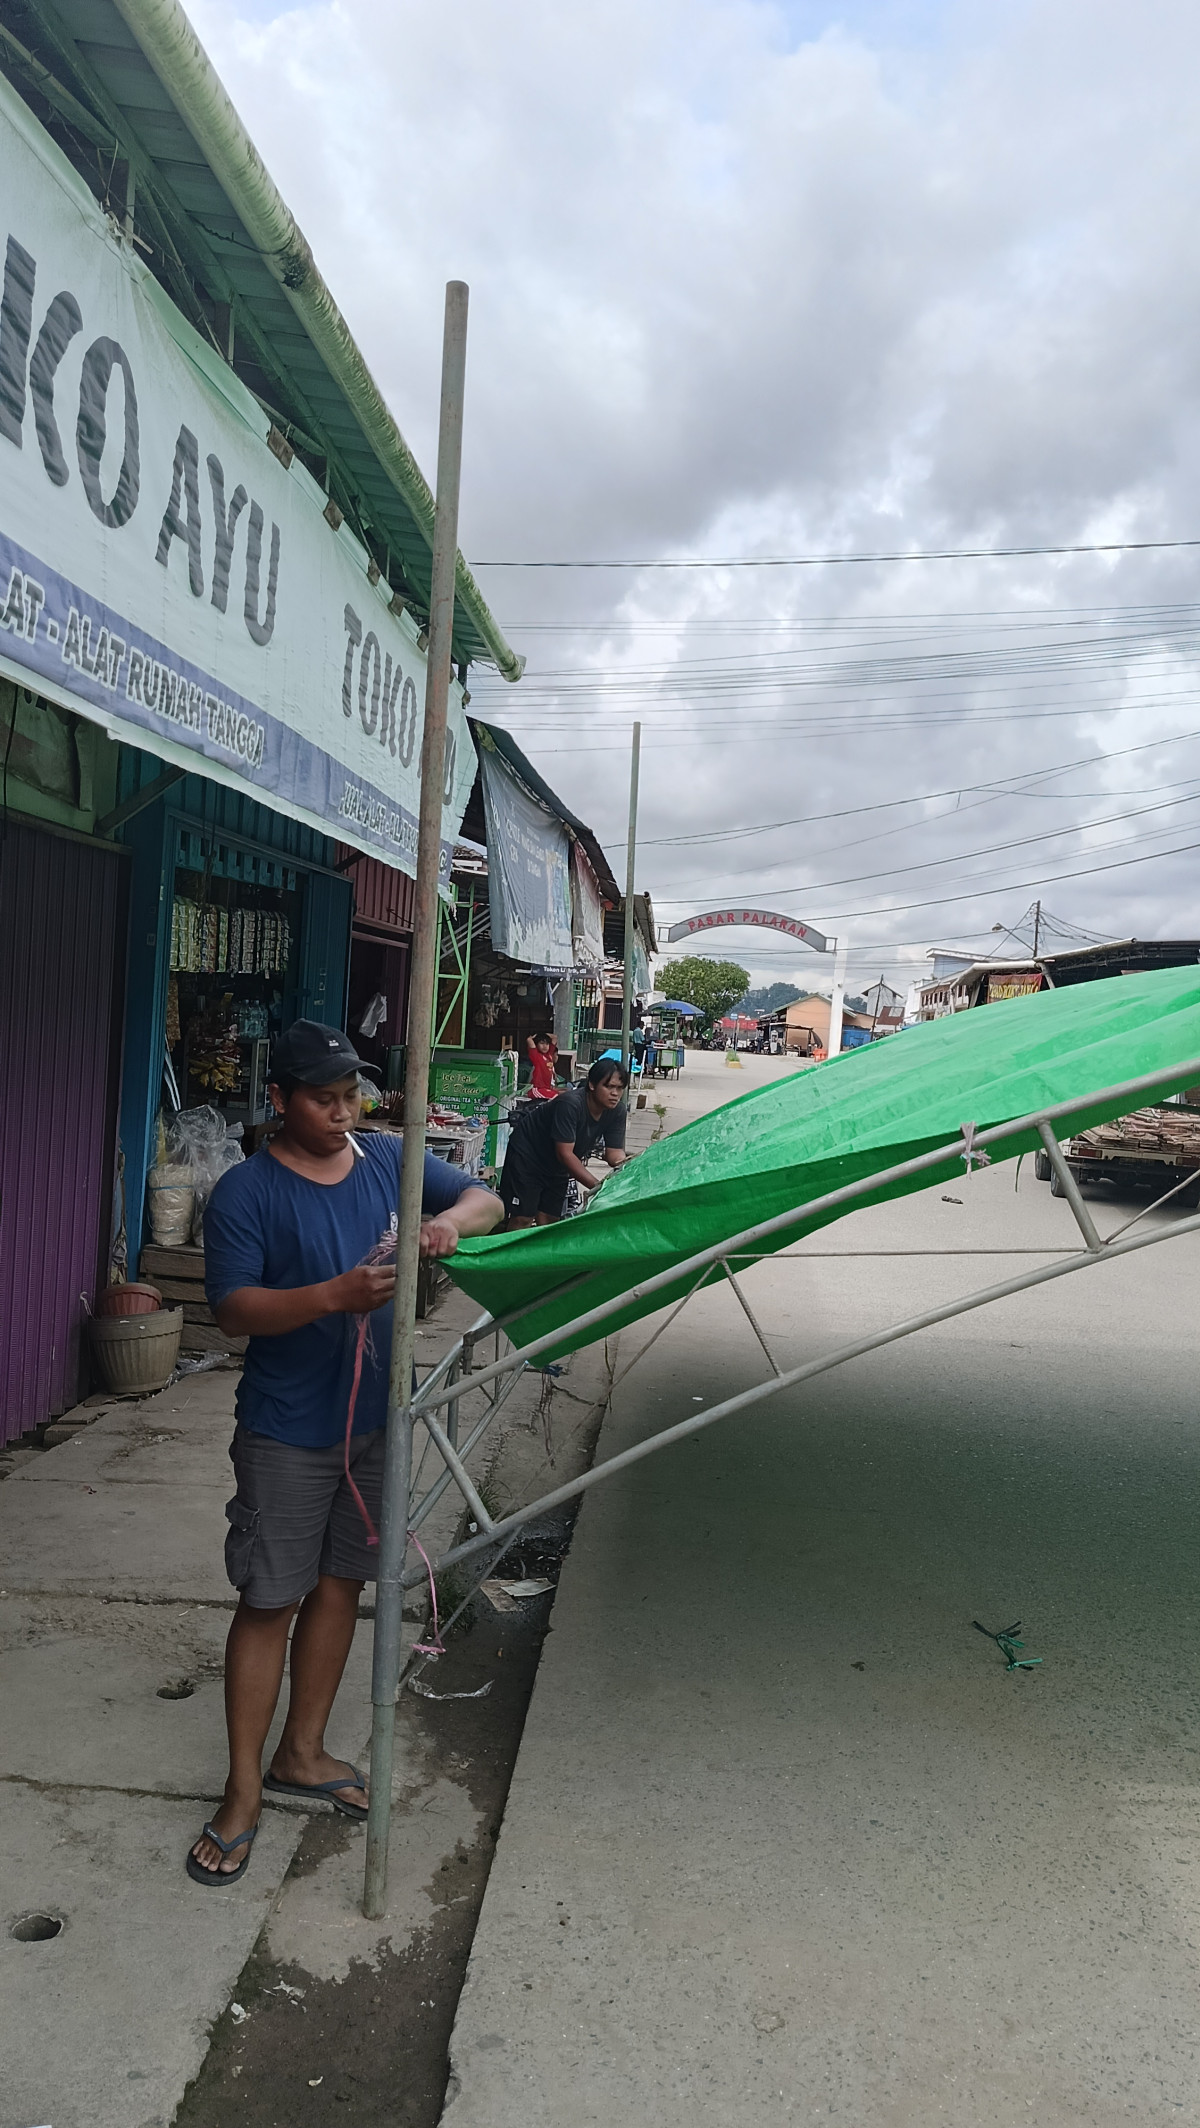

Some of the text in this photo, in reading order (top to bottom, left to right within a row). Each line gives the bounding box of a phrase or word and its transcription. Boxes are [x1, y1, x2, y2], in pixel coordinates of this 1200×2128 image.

[155, 424, 281, 647] AYU
[0, 565, 46, 645] AT
[61, 605, 127, 692] ALAT
[125, 645, 202, 735] RUMAH
[205, 691, 265, 770] TANGGA
[341, 602, 417, 769] TOKO
[688, 912, 808, 939] PASAR PALARAN
[440, 1095, 461, 1103] ORIGINAL
